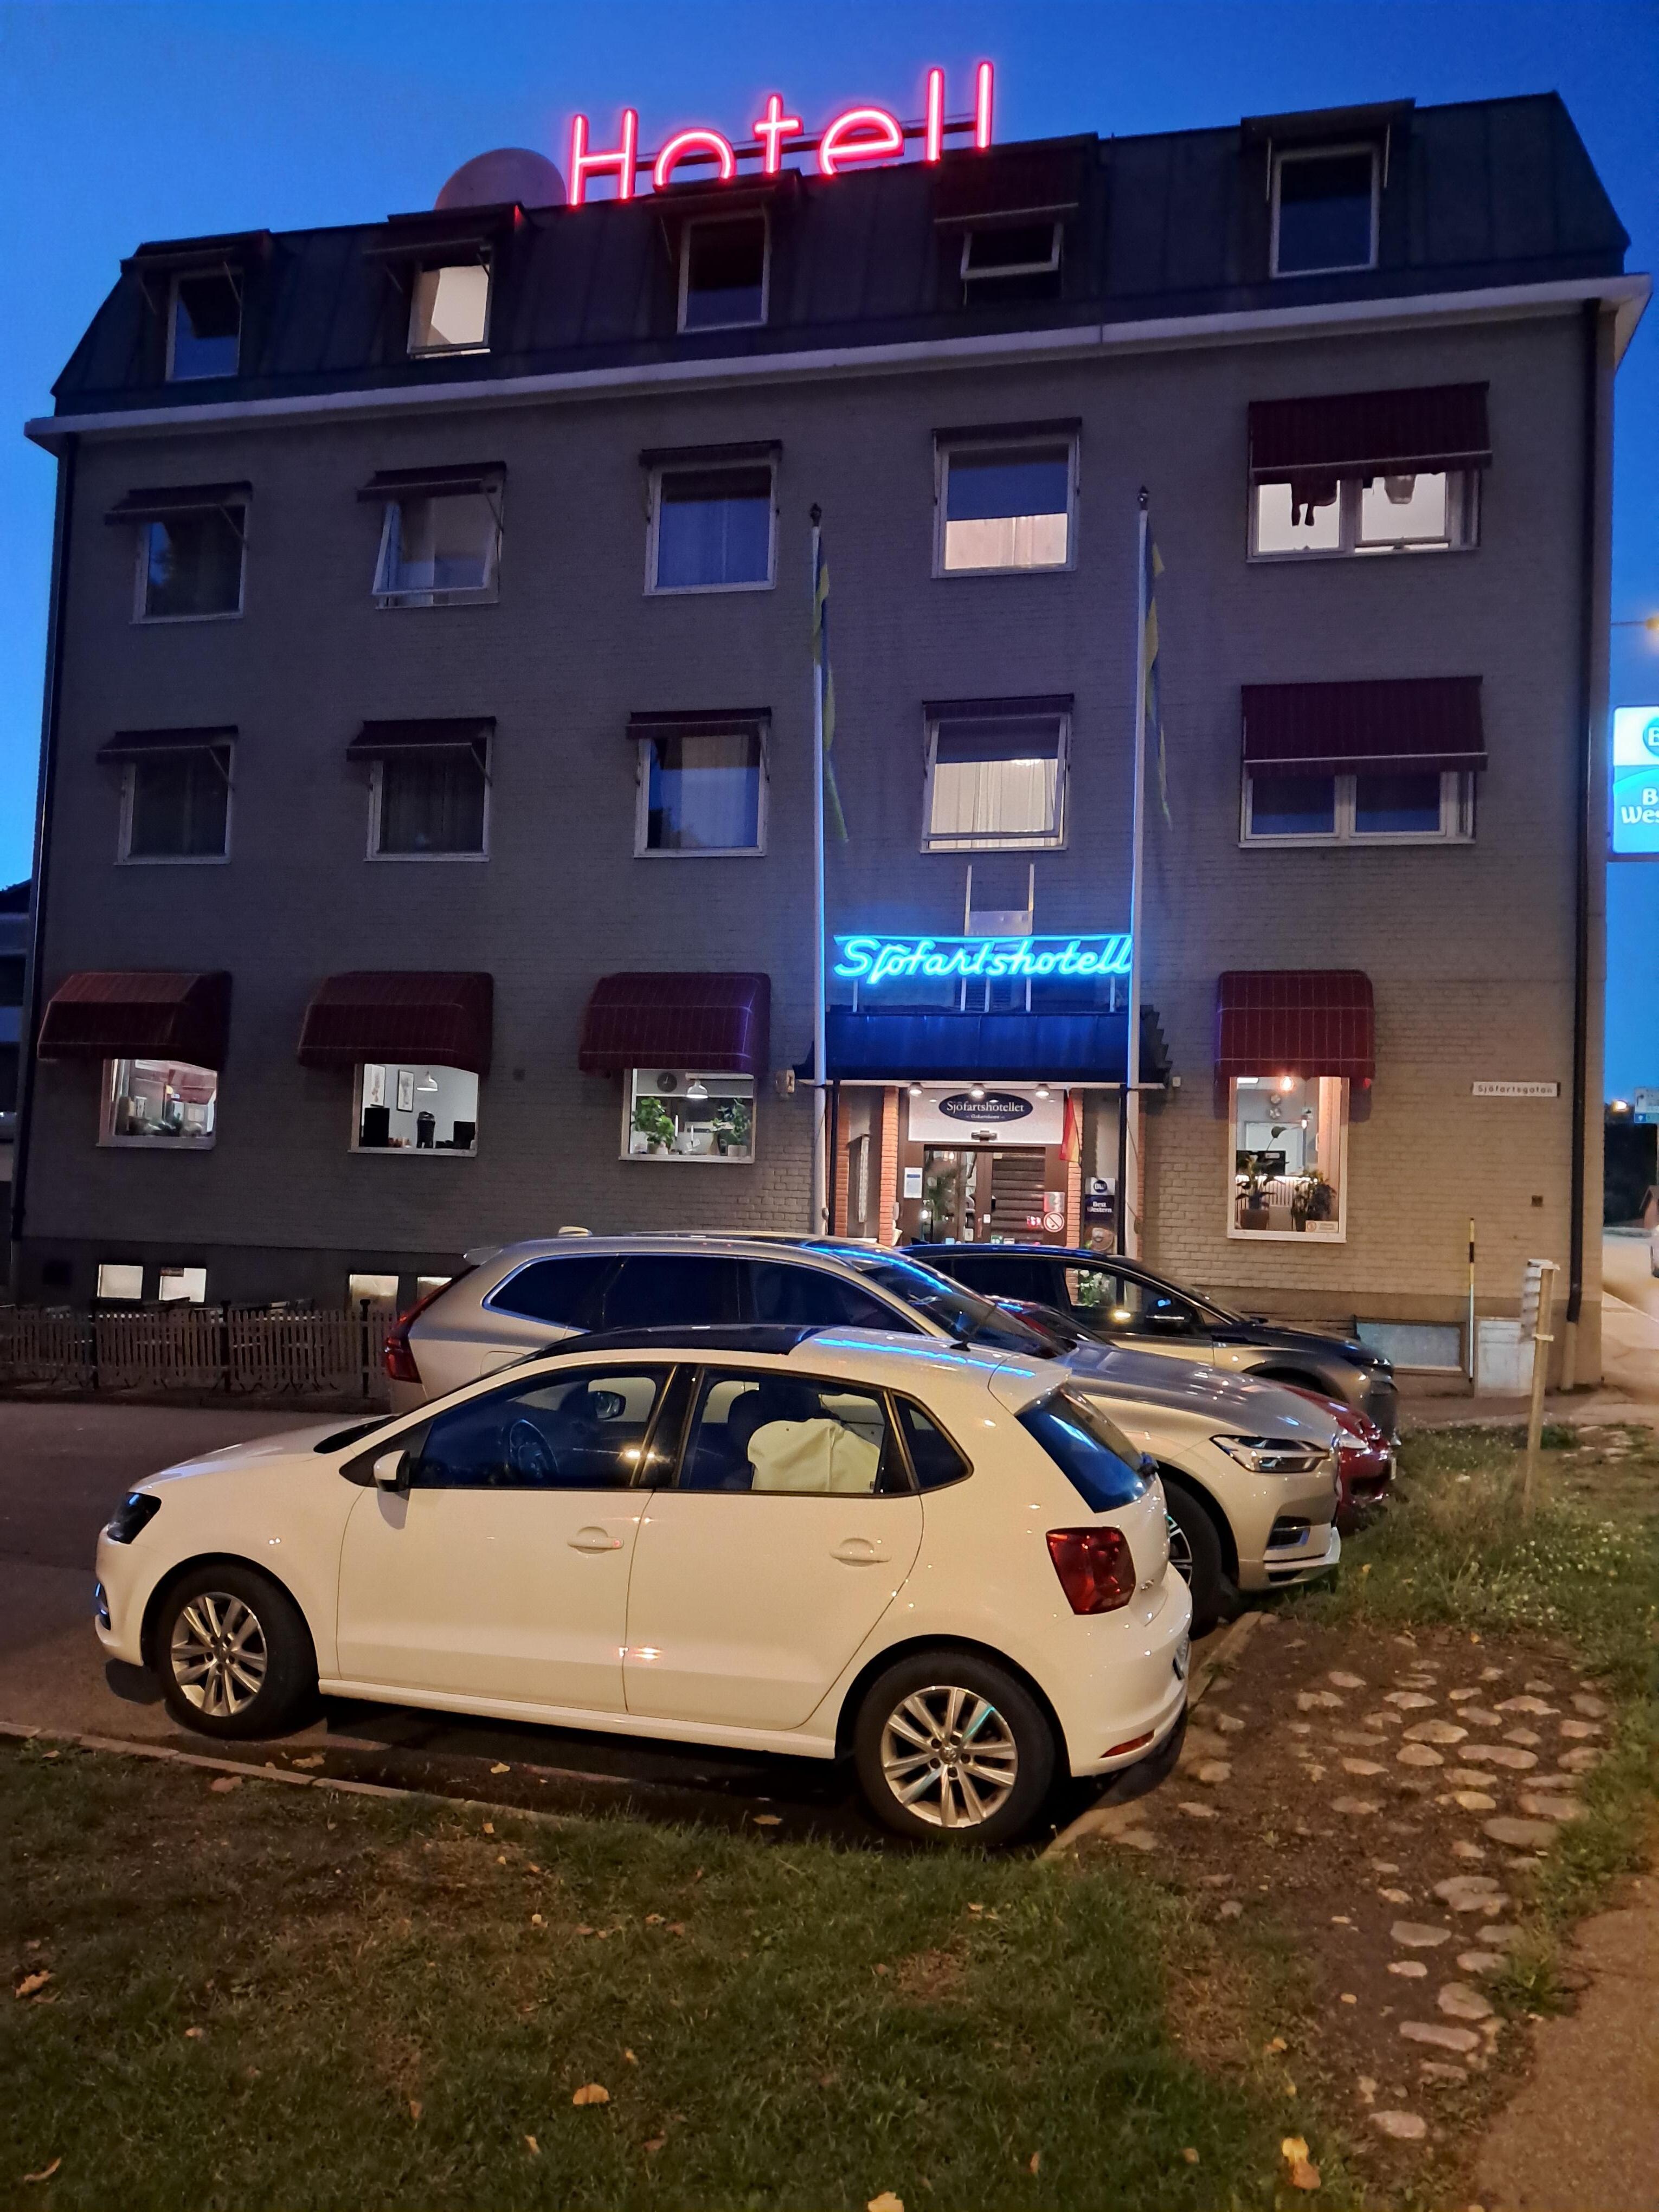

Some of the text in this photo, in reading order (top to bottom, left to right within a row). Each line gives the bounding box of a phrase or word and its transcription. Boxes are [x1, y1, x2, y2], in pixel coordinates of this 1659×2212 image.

[567, 61, 994, 208] Hotell
[1648, 726, 1659, 747] B
[1642, 788, 1659, 806] B
[946, 1101, 1024, 1114] Sjöfartshotellet
